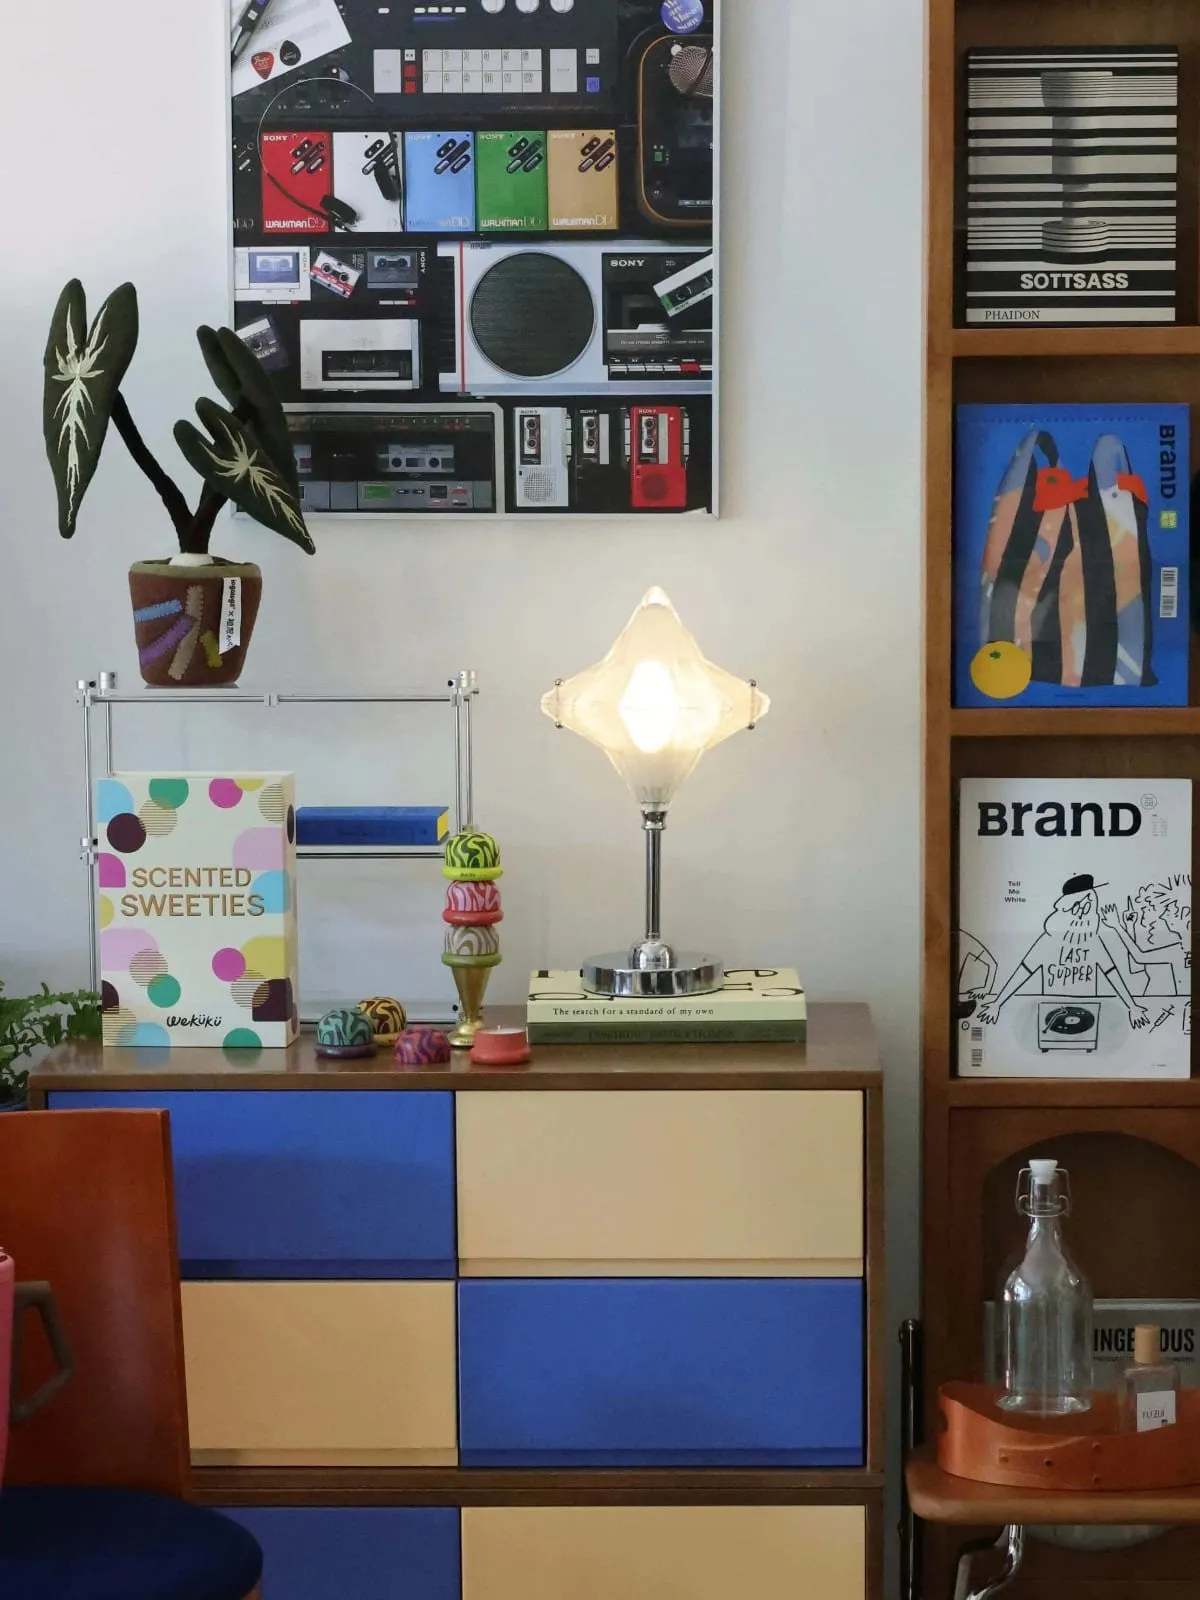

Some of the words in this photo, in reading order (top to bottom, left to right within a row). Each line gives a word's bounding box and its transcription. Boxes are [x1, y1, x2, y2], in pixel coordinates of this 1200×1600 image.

[610, 259, 645, 267] SONY
[1020, 272, 1129, 290] SOTTSASS
[984, 310, 1041, 321] PHAIDON
[131, 867, 252, 889] SCENTED
[120, 894, 266, 918] SWEETIES
[1059, 946, 1090, 966] LAST
[1047, 963, 1094, 987] SUPPER
[553, 1007, 569, 1016] The
[572, 1007, 599, 1016] search
[602, 1007, 616, 1016] for
[626, 1007, 664, 1016] standard
[666, 1006, 676, 1015] of
[679, 1009, 692, 1017] my
[1093, 1328, 1195, 1353] INGEOUS
